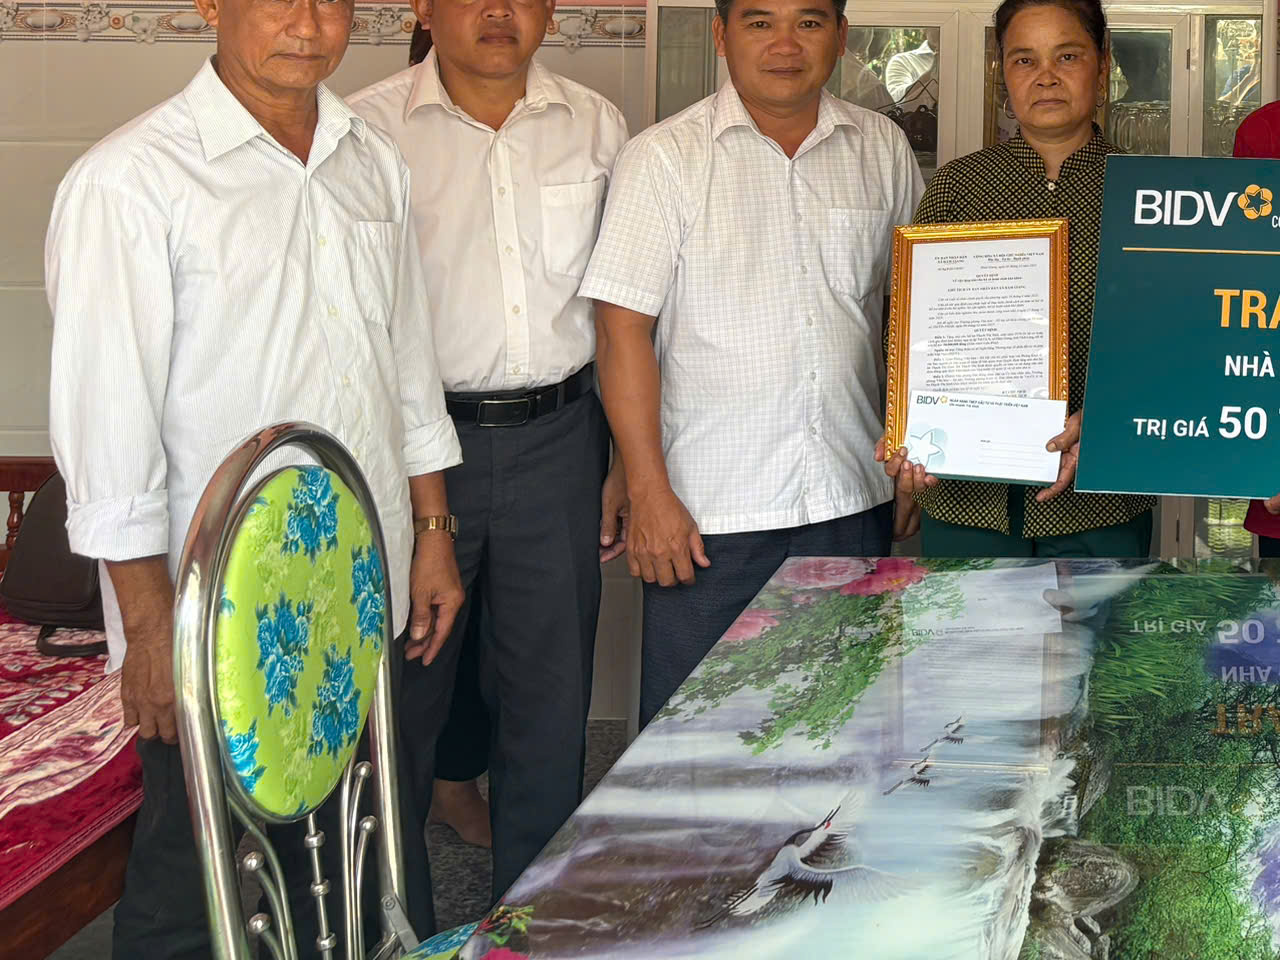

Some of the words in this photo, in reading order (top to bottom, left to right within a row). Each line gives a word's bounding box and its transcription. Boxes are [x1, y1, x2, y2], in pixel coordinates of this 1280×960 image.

[1134, 189, 1239, 227] BIDV
[1224, 351, 1275, 378] NHÀ
[916, 395, 940, 405] BIDV
[1133, 418, 1168, 440] TRỊ
[1173, 416, 1209, 438] GIÁ
[1218, 405, 1268, 439] 50
